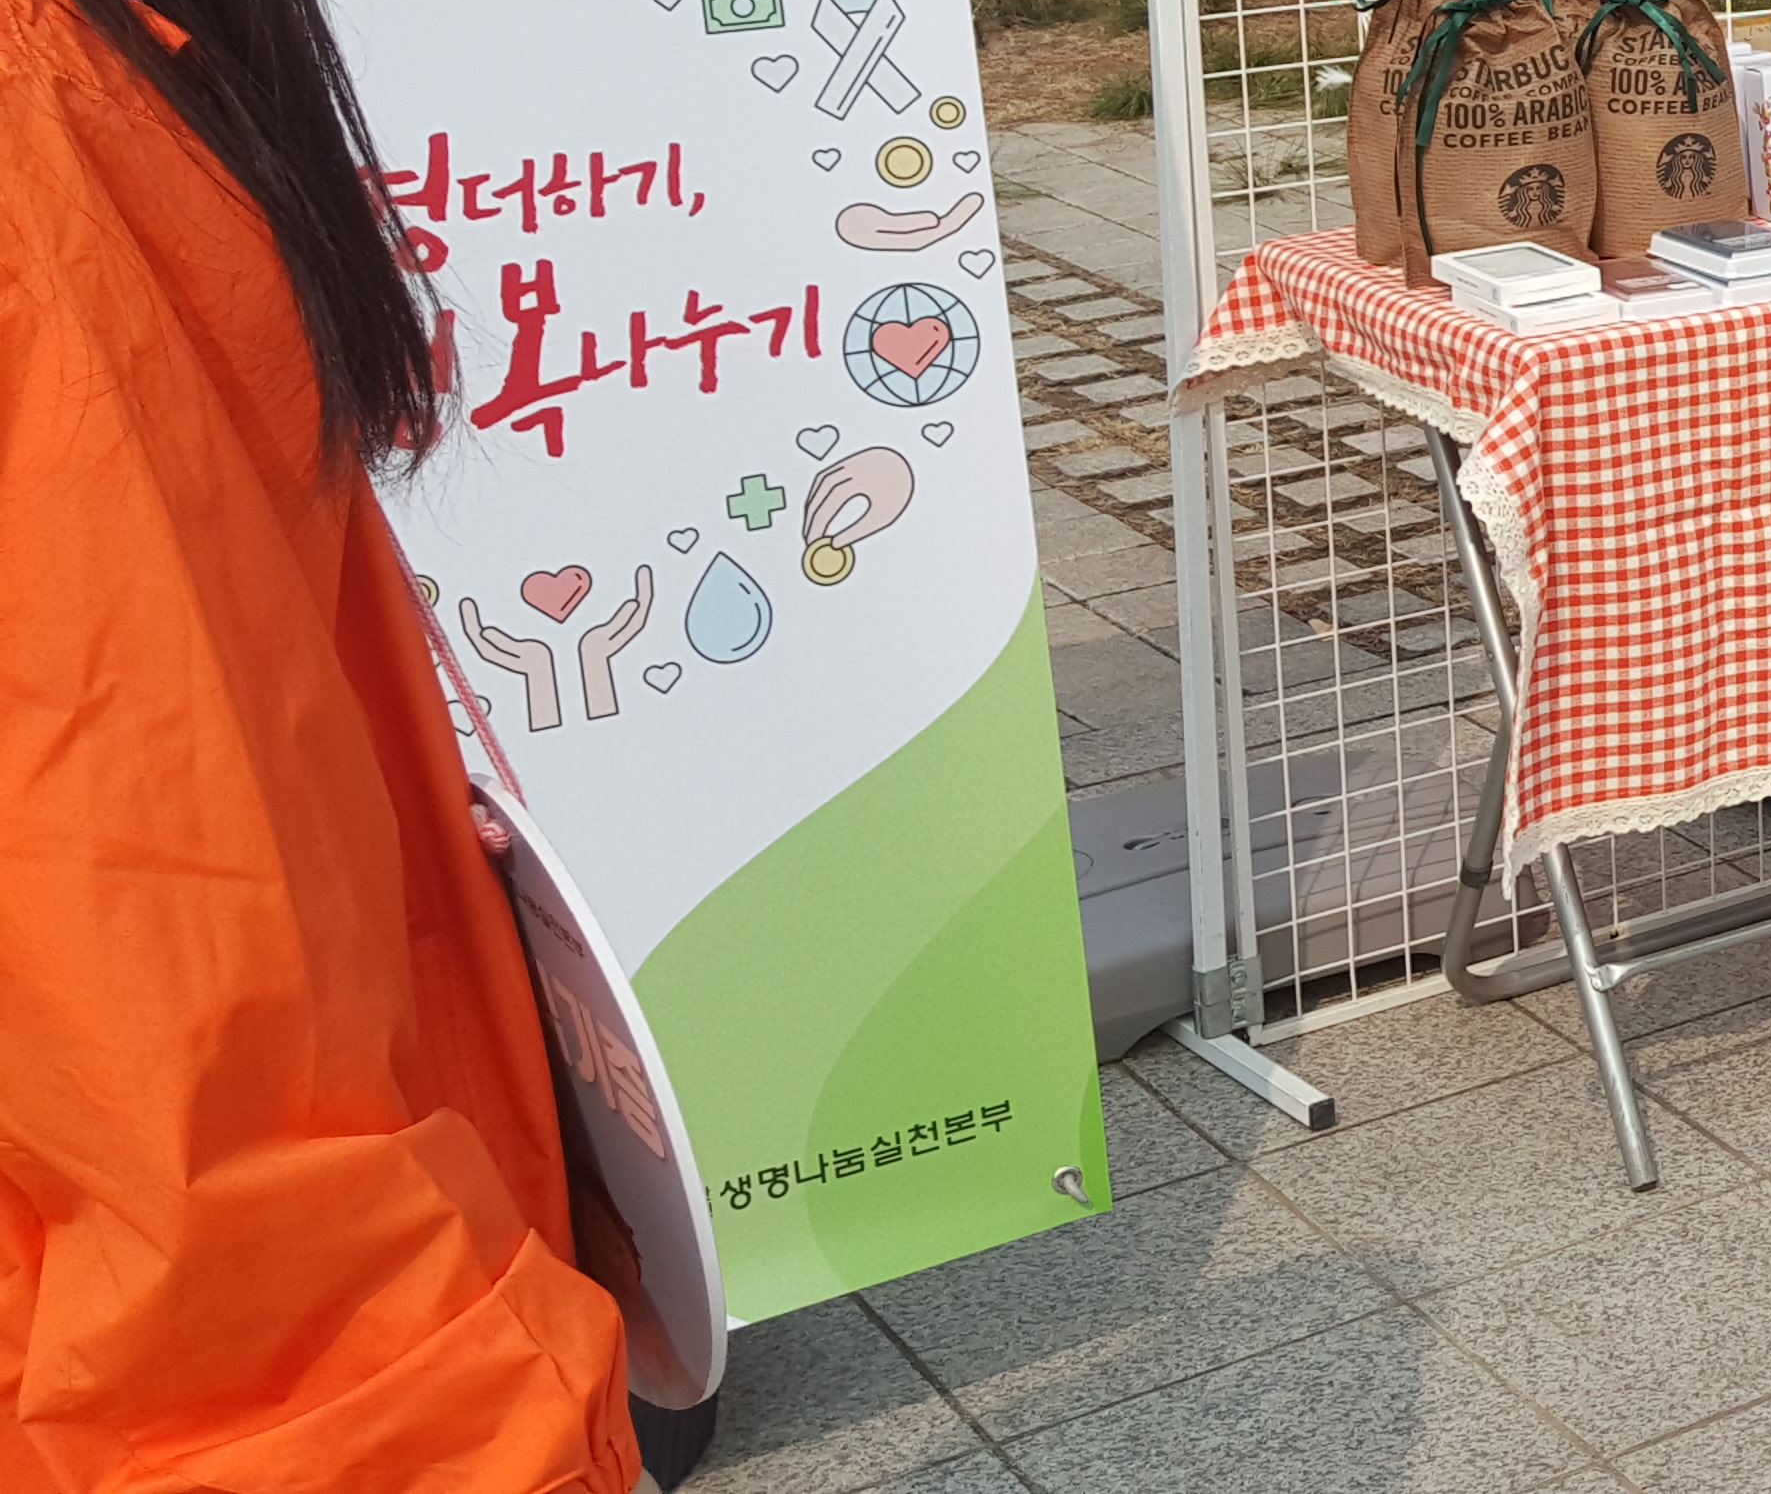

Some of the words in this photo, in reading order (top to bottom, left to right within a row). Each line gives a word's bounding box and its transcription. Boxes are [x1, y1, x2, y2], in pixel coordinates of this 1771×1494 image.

[1453, 44, 1570, 93] STARBUC
[1526, 71, 1579, 97] COMPA
[1610, 67, 1666, 96] 100%
[1444, 102, 1506, 130] 100%
[1512, 84, 1588, 126] ARABIC
[1607, 97, 1690, 115] COFFEE
[1443, 130, 1534, 148] COFFEE
[1548, 115, 1589, 141] BEAN
[395, 259, 824, 458] 복나누기
[718, 1098, 1015, 1214] 생명나눔실천본부
